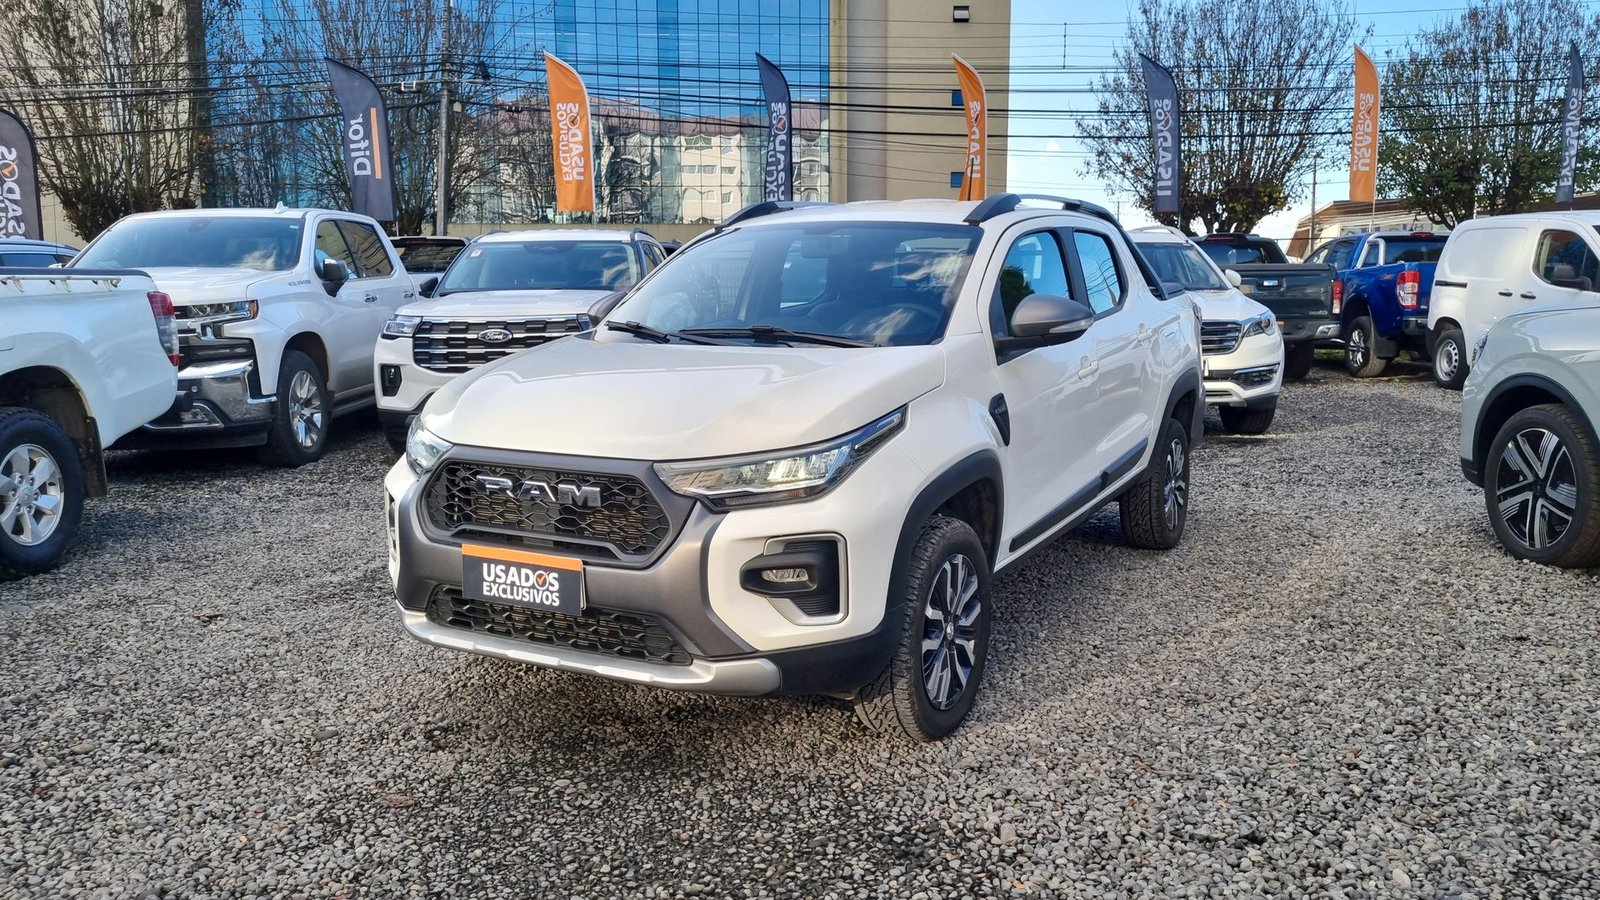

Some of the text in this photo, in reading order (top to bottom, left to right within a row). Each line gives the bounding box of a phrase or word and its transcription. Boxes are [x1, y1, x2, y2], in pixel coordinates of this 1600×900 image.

[476, 475, 601, 507] RAM
[482, 562, 560, 592] USADOS
[482, 581, 560, 607] EXCLUSIVOS
